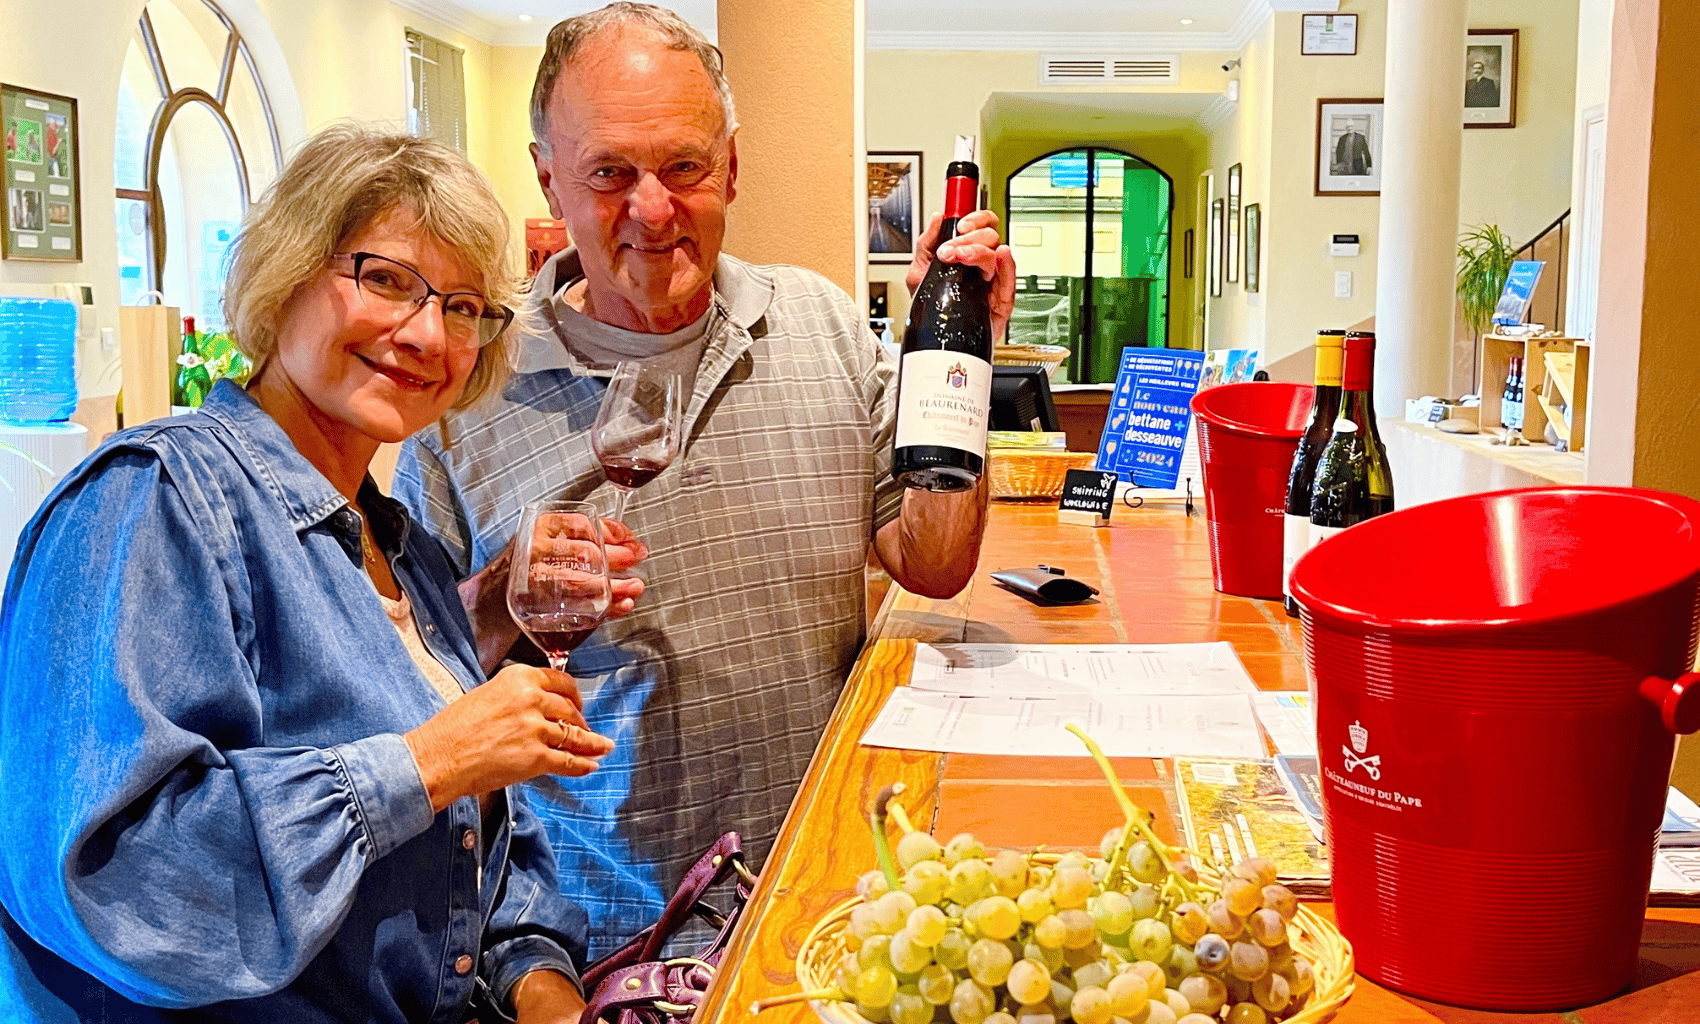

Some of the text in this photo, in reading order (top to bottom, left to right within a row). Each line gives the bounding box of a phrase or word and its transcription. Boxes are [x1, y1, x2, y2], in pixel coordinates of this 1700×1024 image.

[933, 392, 965, 402] DOMAINE
[919, 399, 983, 418] BEAURENARD
[1128, 411, 1171, 431] bettane
[1124, 427, 1182, 448] desseauve
[1136, 451, 1174, 468] 2024
[1377, 790, 1392, 801] DU
[1394, 792, 1422, 808] PAPE
